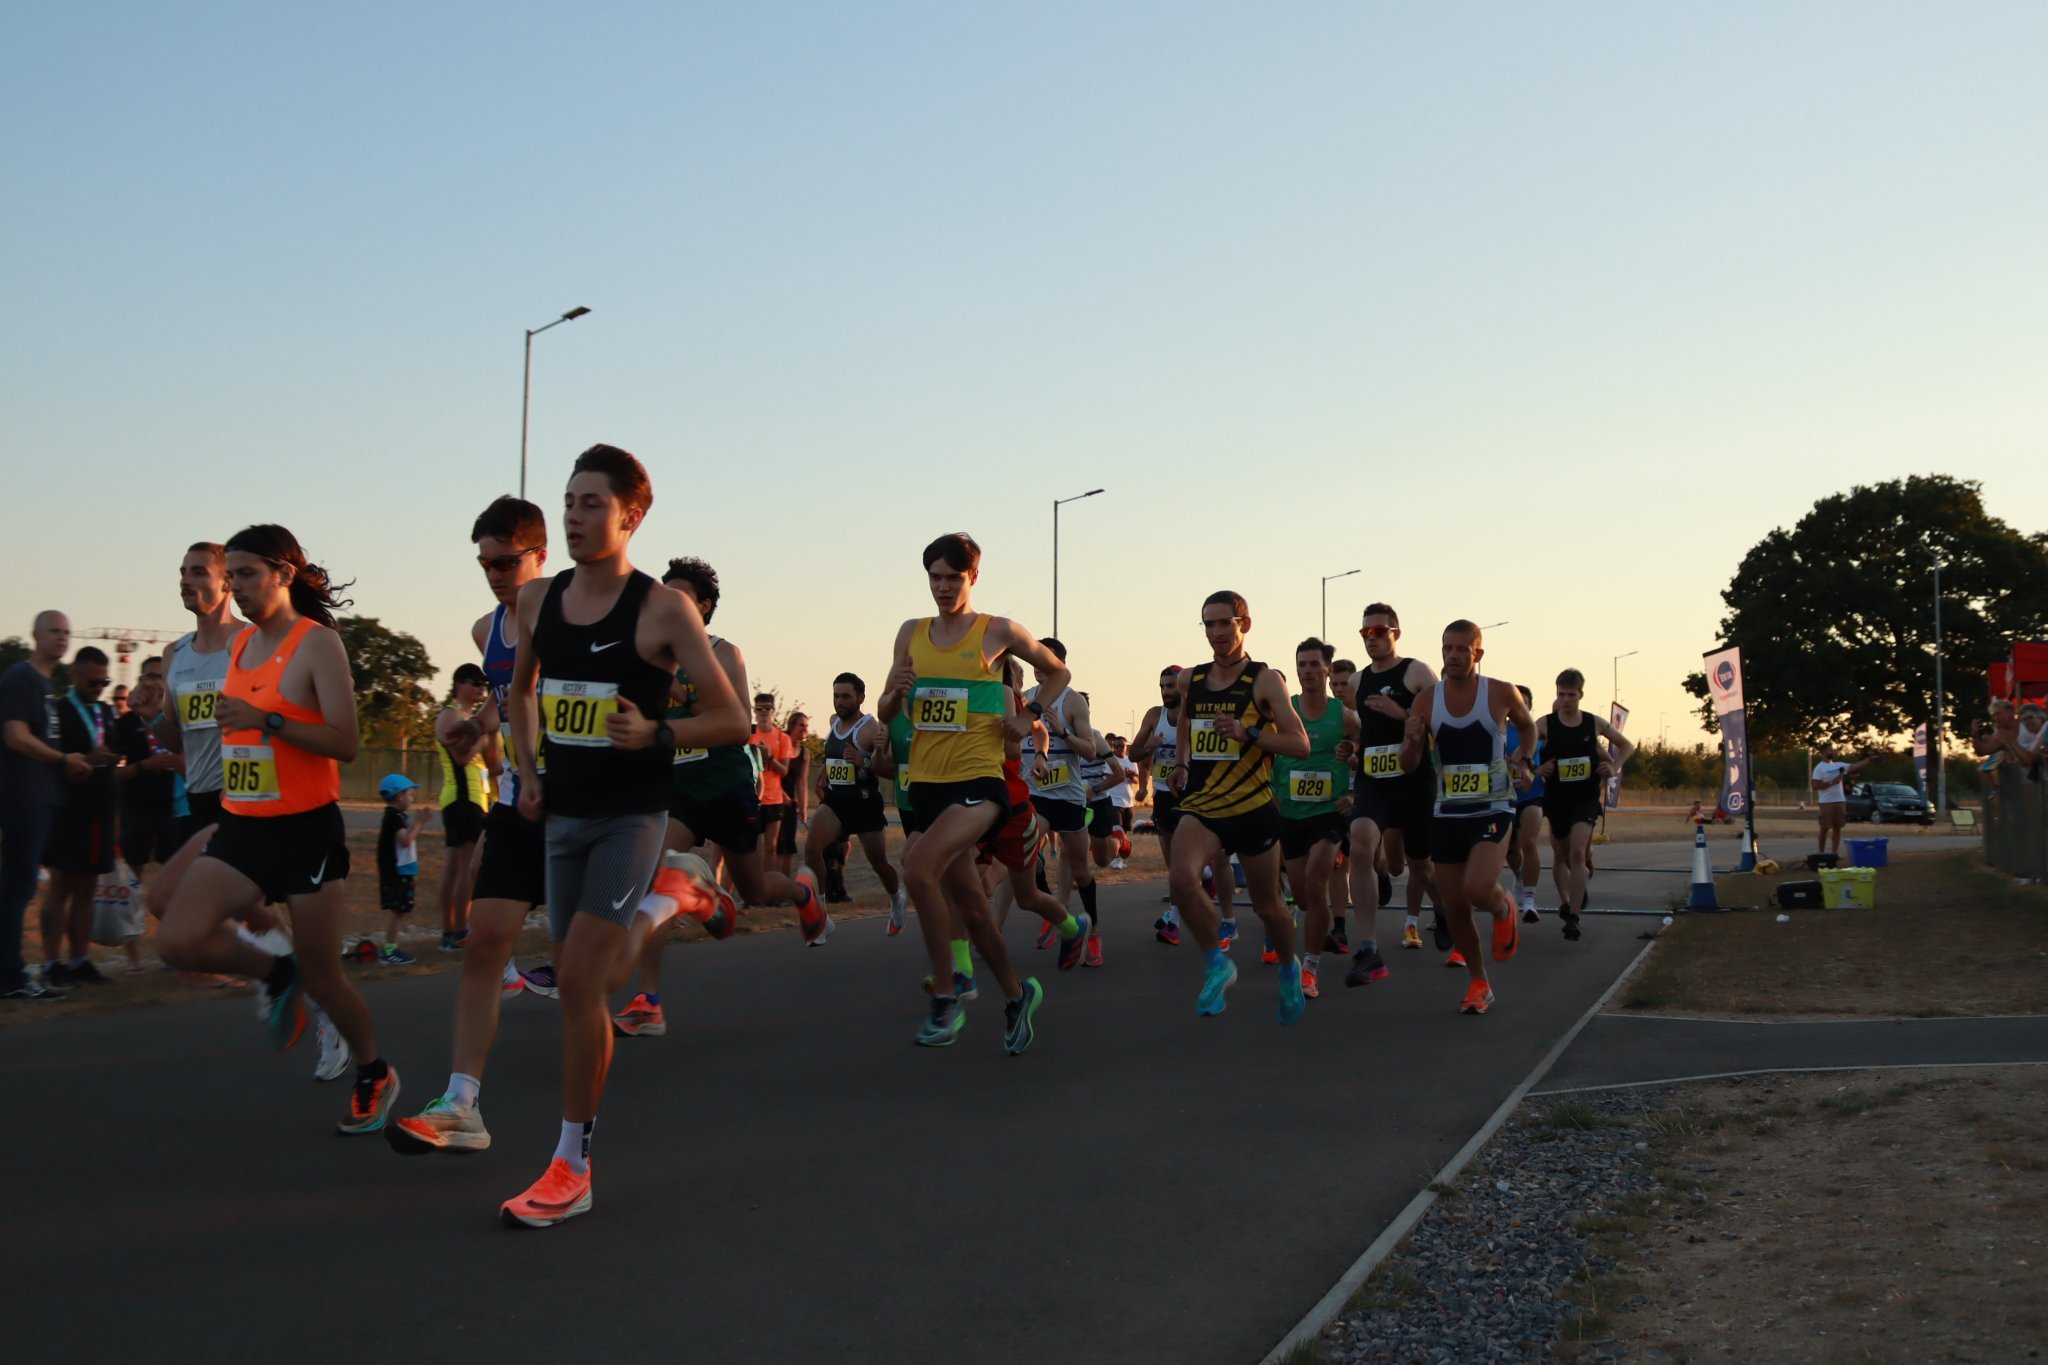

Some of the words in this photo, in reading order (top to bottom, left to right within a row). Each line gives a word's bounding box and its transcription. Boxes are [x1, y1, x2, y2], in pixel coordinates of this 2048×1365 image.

[196, 681, 216, 689] ACTIVE
[562, 684, 588, 693] ACTIVE
[929, 689, 947, 697] ACTIVE
[188, 693, 220, 721] 83
[921, 700, 957, 722] 835
[1195, 703, 1236, 711] WITHAM
[555, 699, 598, 734] 801
[1371, 754, 1397, 773] 805
[1566, 764, 1585, 777] 793
[228, 762, 260, 791] 815
[829, 766, 848, 780] 883
[1297, 780, 1324, 796] 829
[1452, 773, 1480, 792] 823
